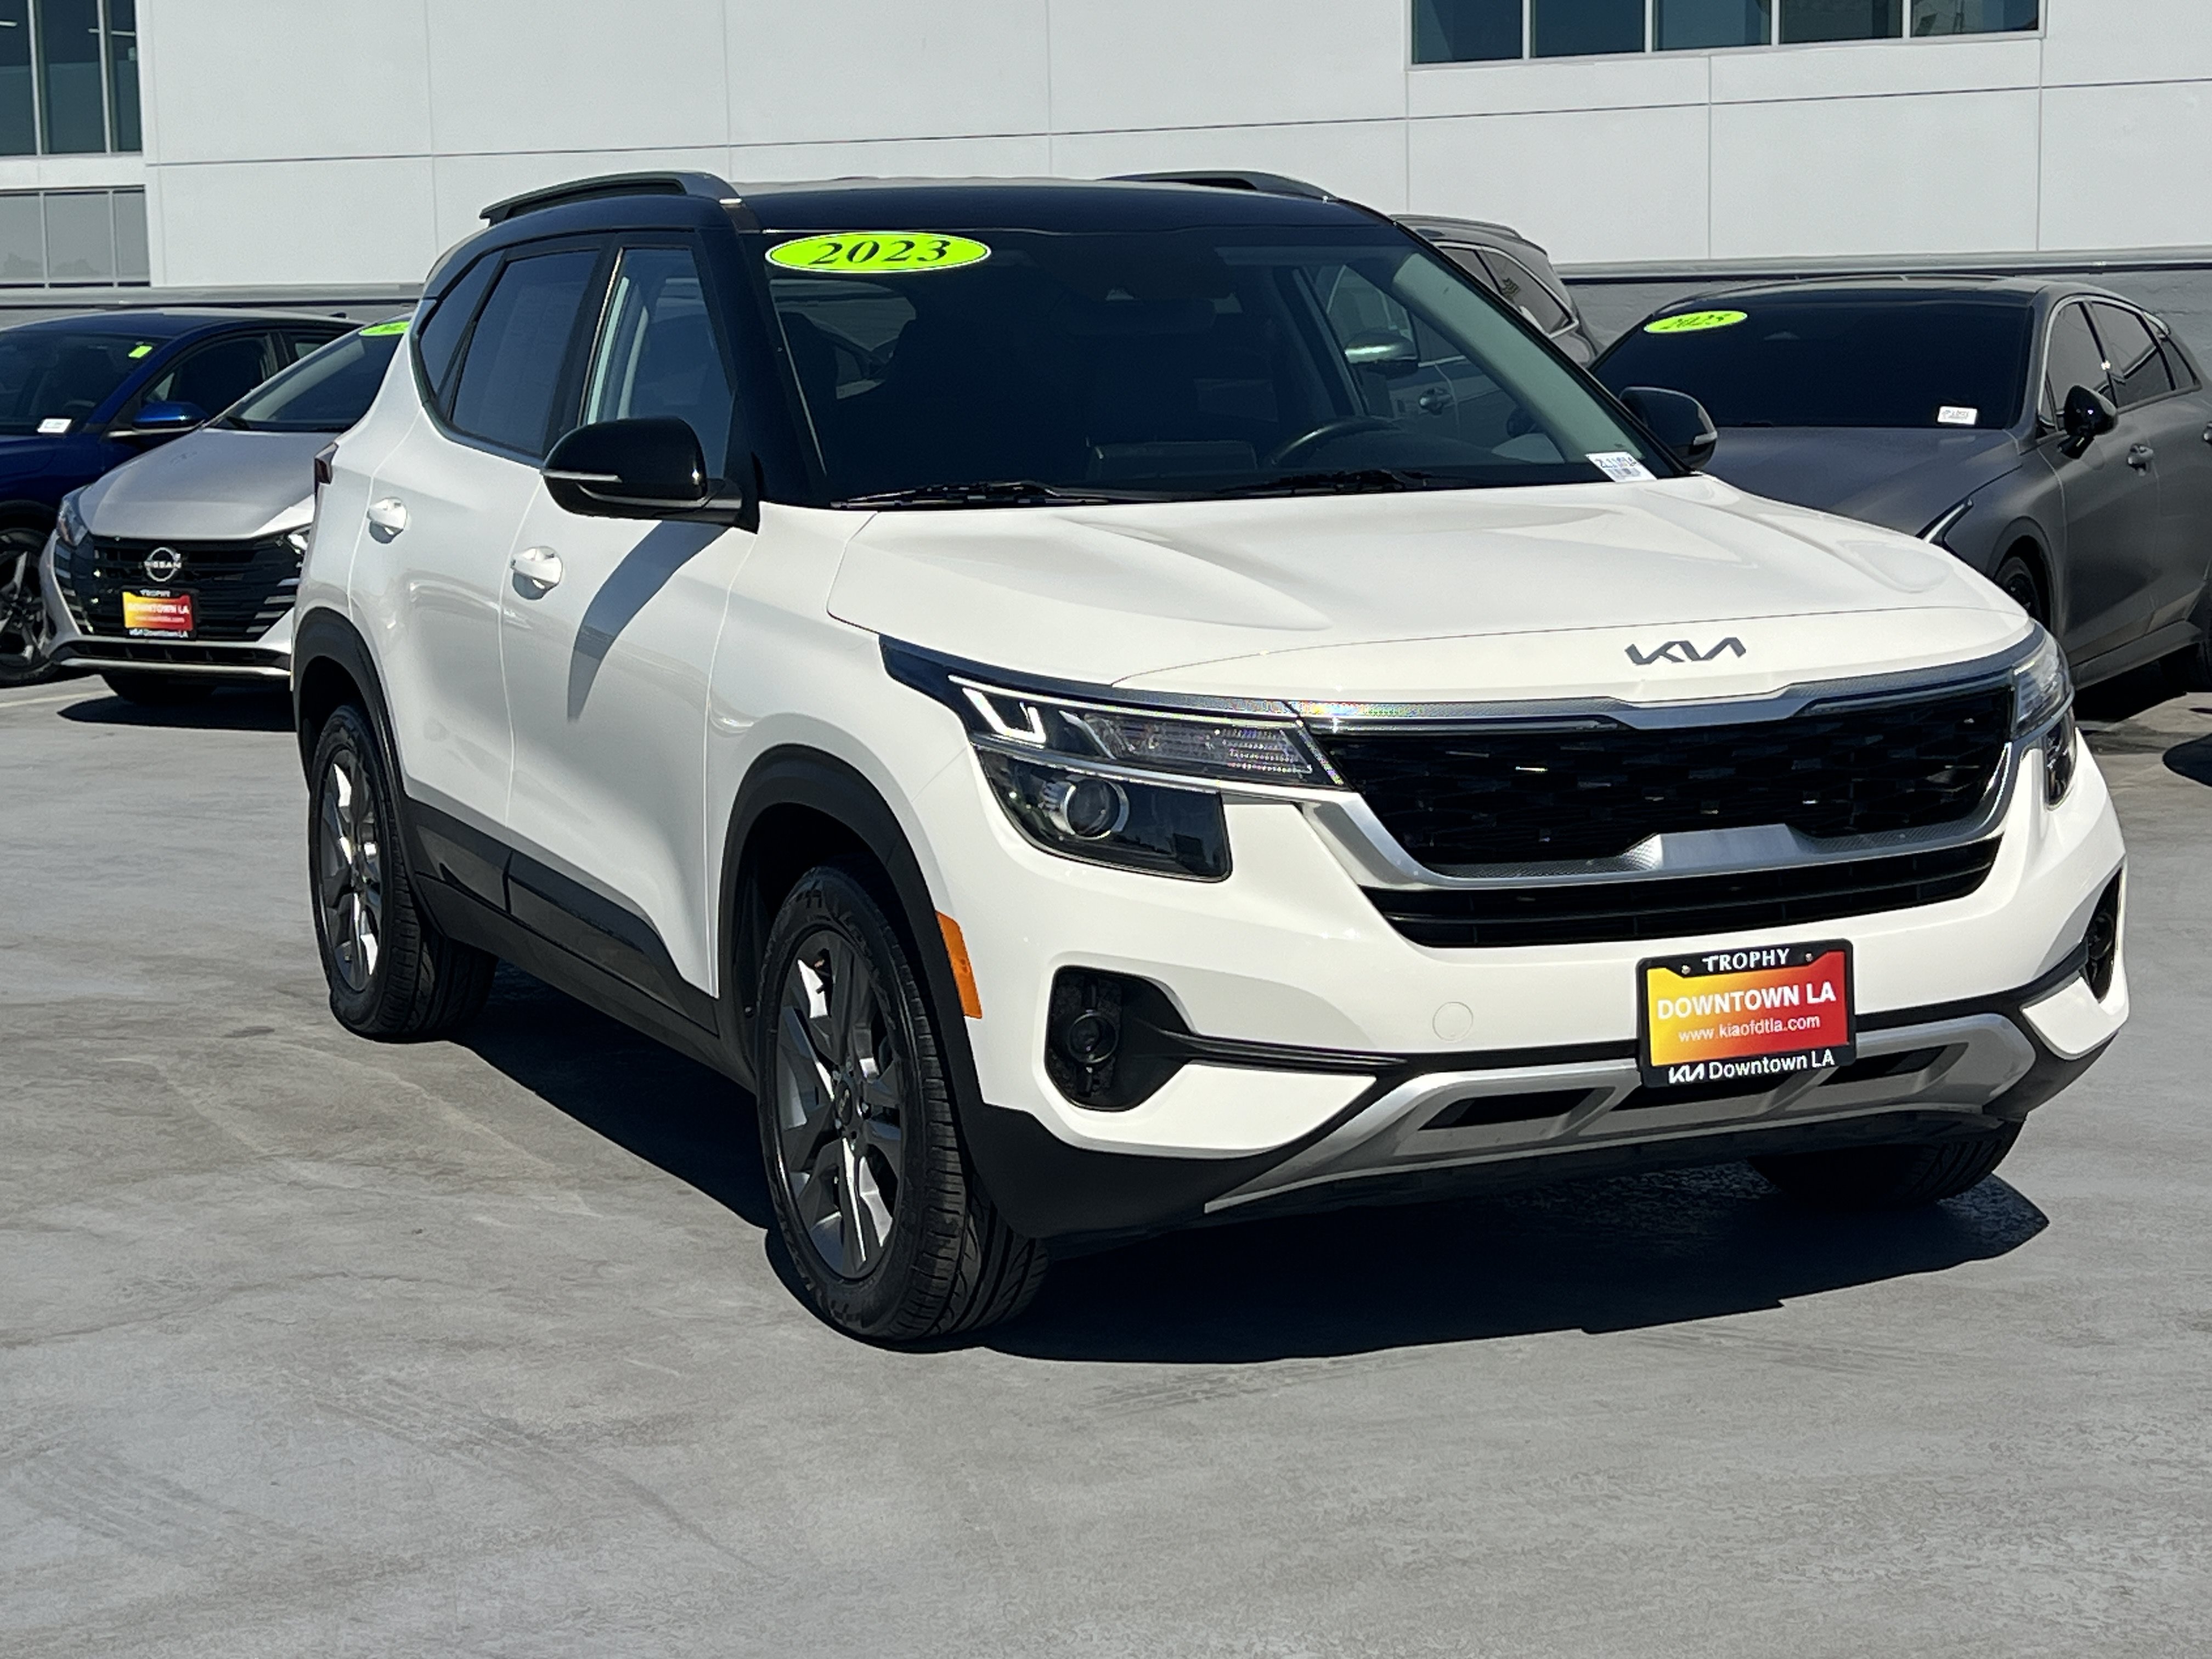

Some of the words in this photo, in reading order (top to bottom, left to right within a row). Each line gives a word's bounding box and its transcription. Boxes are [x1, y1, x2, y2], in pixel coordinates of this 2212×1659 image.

[808, 240, 951, 265] 2023
[1624, 637, 1746, 665] KIA
[1702, 948, 1790, 972] TROPHY
[1657, 984, 1799, 1019] DOWNTOWN
[1806, 981, 1837, 1004] LA
[1668, 1063, 1705, 1084] KIA
[1708, 1054, 1808, 1080] Downtown
[1811, 1048, 1836, 1068] LA
